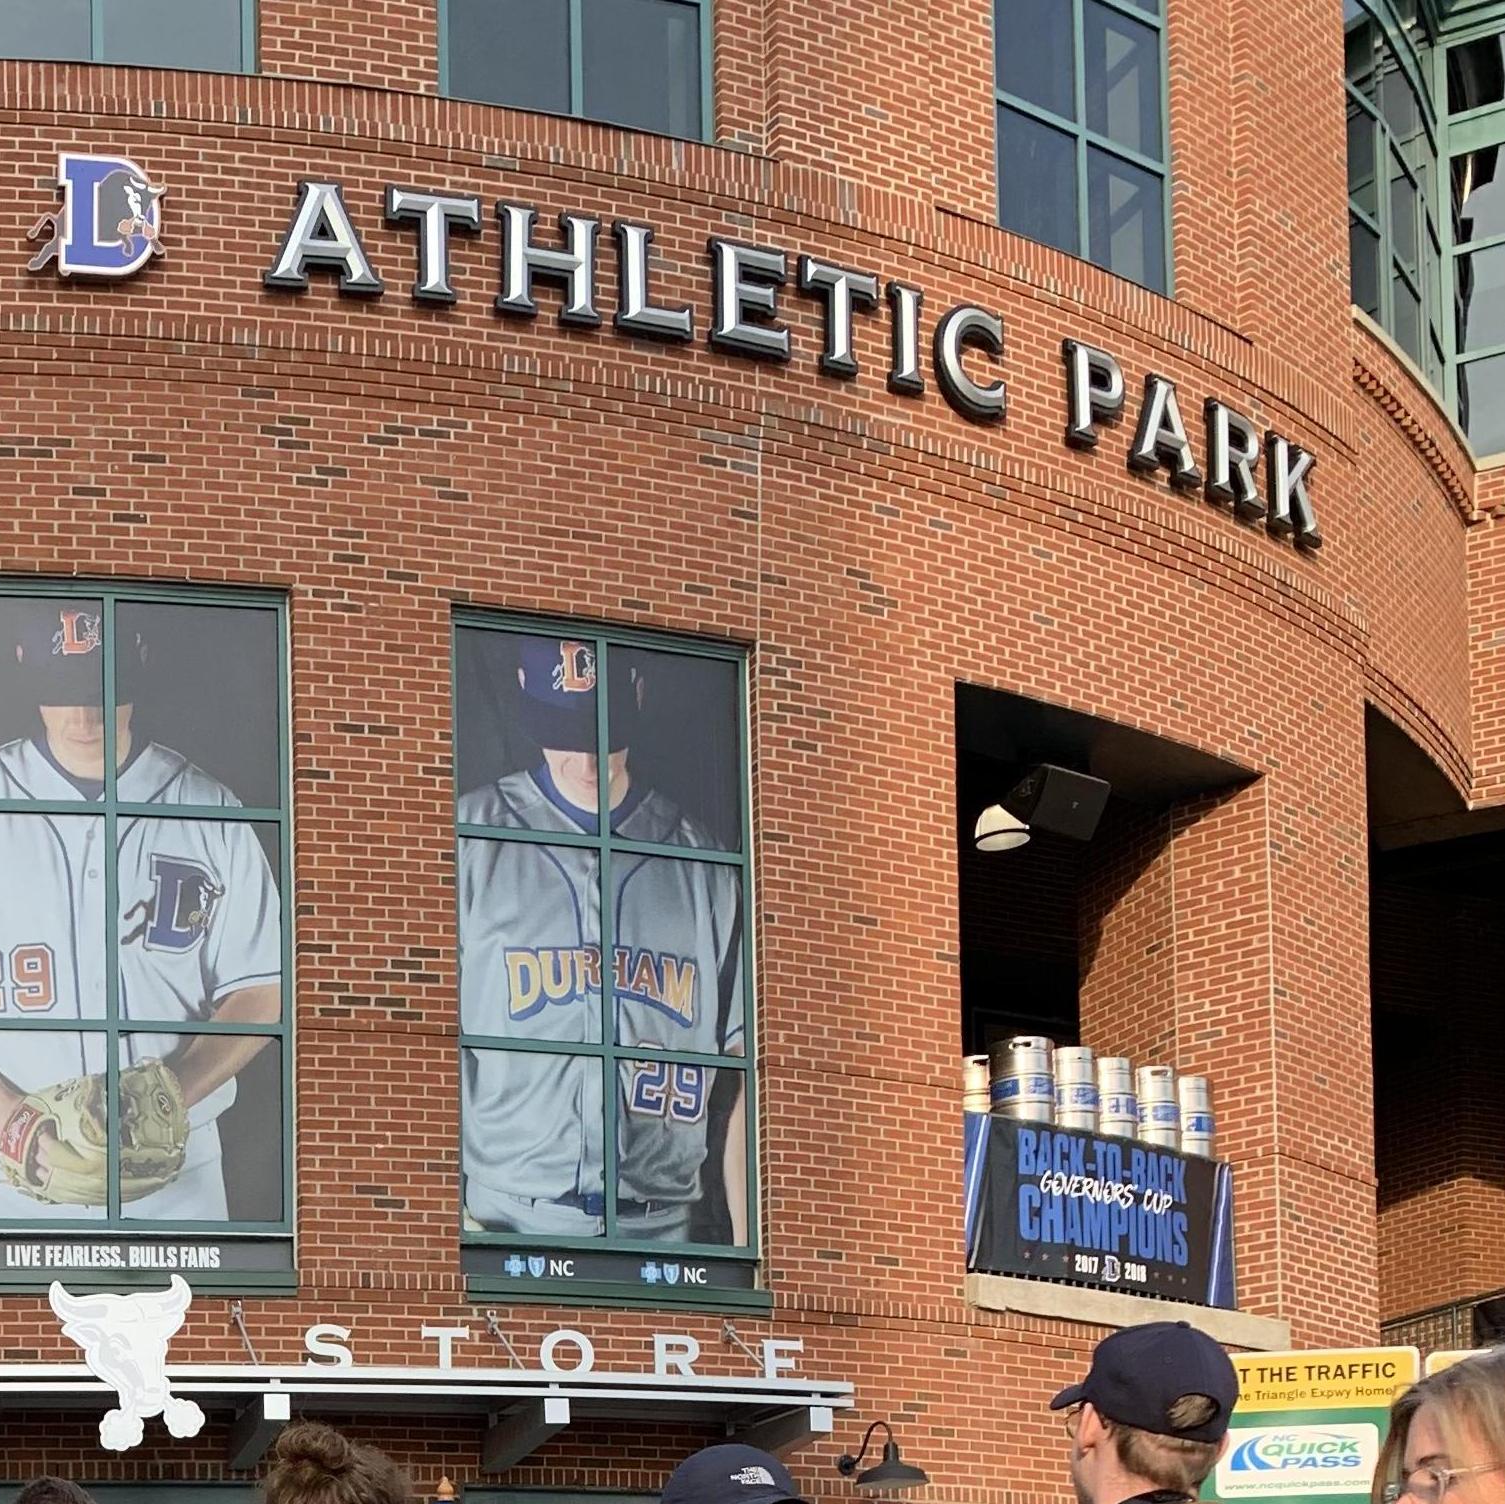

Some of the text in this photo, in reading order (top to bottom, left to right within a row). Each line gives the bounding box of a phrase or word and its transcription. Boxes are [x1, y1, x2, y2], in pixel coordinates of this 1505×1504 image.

[263, 180, 1006, 423] ATHLETIC
[1062, 337, 1322, 549] PARK
[504, 942, 696, 1029] DURHAM
[630, 1040, 706, 1123] 29
[1017, 1128, 1188, 1204] BACK-TO-BACK
[1143, 1188, 1173, 1216] CUP
[1017, 1183, 1189, 1266] CHAMPIONS
[6, 1244, 221, 1268] LIVE FEARLESS. BULLS FANS
[549, 1259, 575, 1276] NC
[683, 1267, 707, 1284] NC
[1074, 1254, 1098, 1274] 2017
[1124, 1262, 1147, 1283] 2018
[305, 1323, 806, 1380] STORE
[1257, 1366, 1298, 1383] THE
[1304, 1362, 1396, 1381] TRAFFIC
[1256, 1388, 1307, 1401] Triangle
[1311, 1387, 1351, 1399] Expwy
[1262, 1441, 1359, 1457] QUICK
[1272, 1434, 1298, 1442] NC
[1279, 1455, 1362, 1469] PASS
[1225, 1479, 1371, 1491] www.ncquickpass.com
